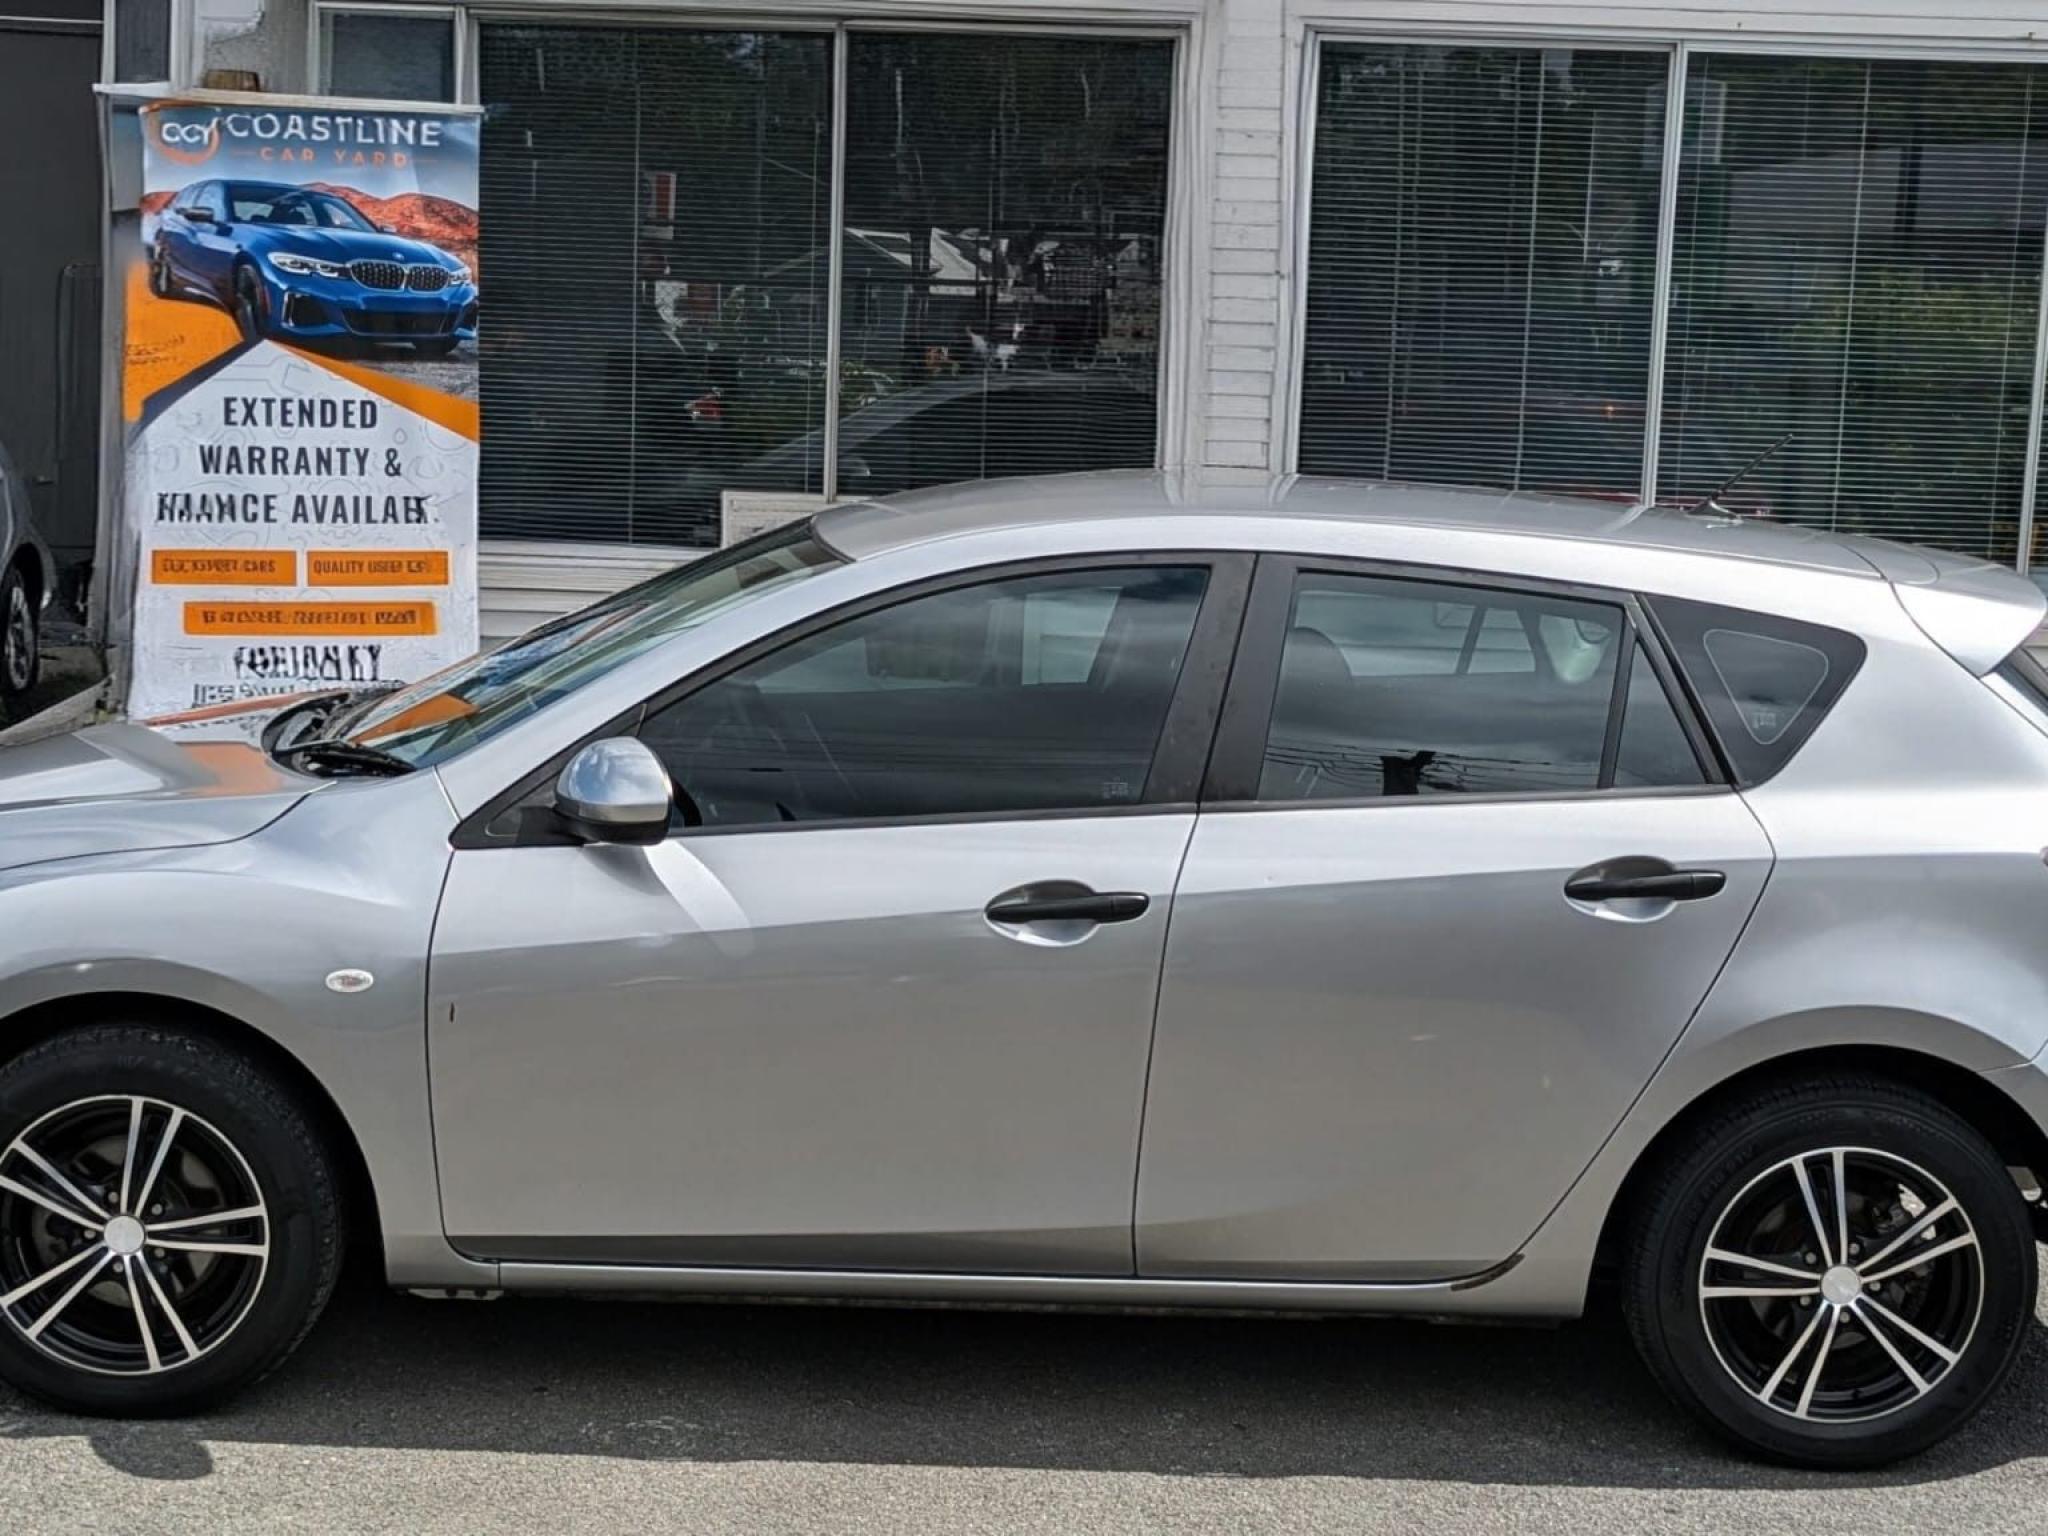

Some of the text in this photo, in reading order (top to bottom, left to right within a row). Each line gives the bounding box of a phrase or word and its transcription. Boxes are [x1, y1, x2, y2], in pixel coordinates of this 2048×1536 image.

[162, 117, 219, 144] CCY
[226, 113, 441, 146] COASTLINE
[260, 146, 408, 168] CAR YARD
[224, 397, 378, 429] EXTENDED
[199, 444, 402, 477] WARRANTY &
[313, 559, 363, 574] QUALITY
